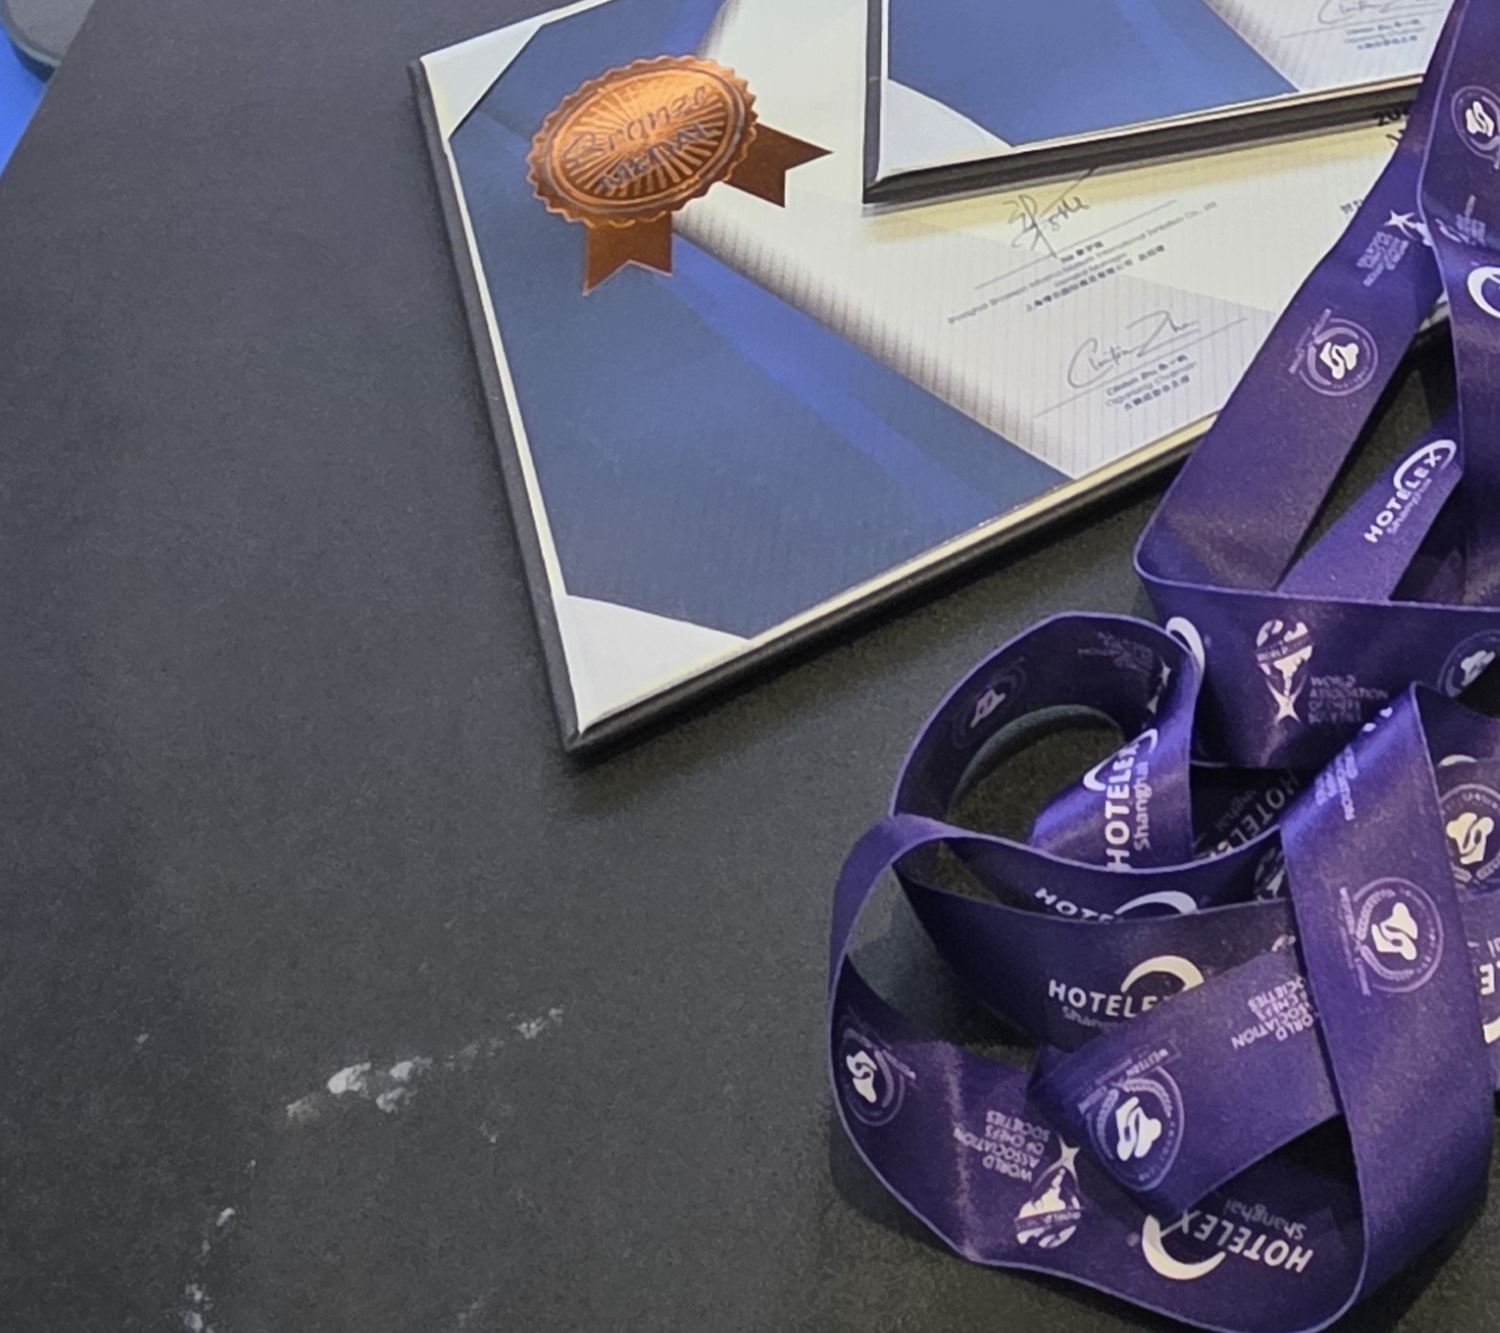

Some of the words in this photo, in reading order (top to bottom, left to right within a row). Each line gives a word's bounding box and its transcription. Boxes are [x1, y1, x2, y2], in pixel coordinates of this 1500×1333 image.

[1363, 446, 1444, 544] HOTELEX
[1132, 761, 1152, 851] Shanghai
[952, 1127, 1041, 1169] ASSOCIATION
[985, 1109, 1052, 1142] SOCIETIES
[982, 1153, 1033, 1184] WORLD
[1223, 1196, 1309, 1241] Shanghai
[1177, 1209, 1314, 1274] HOTELEX
